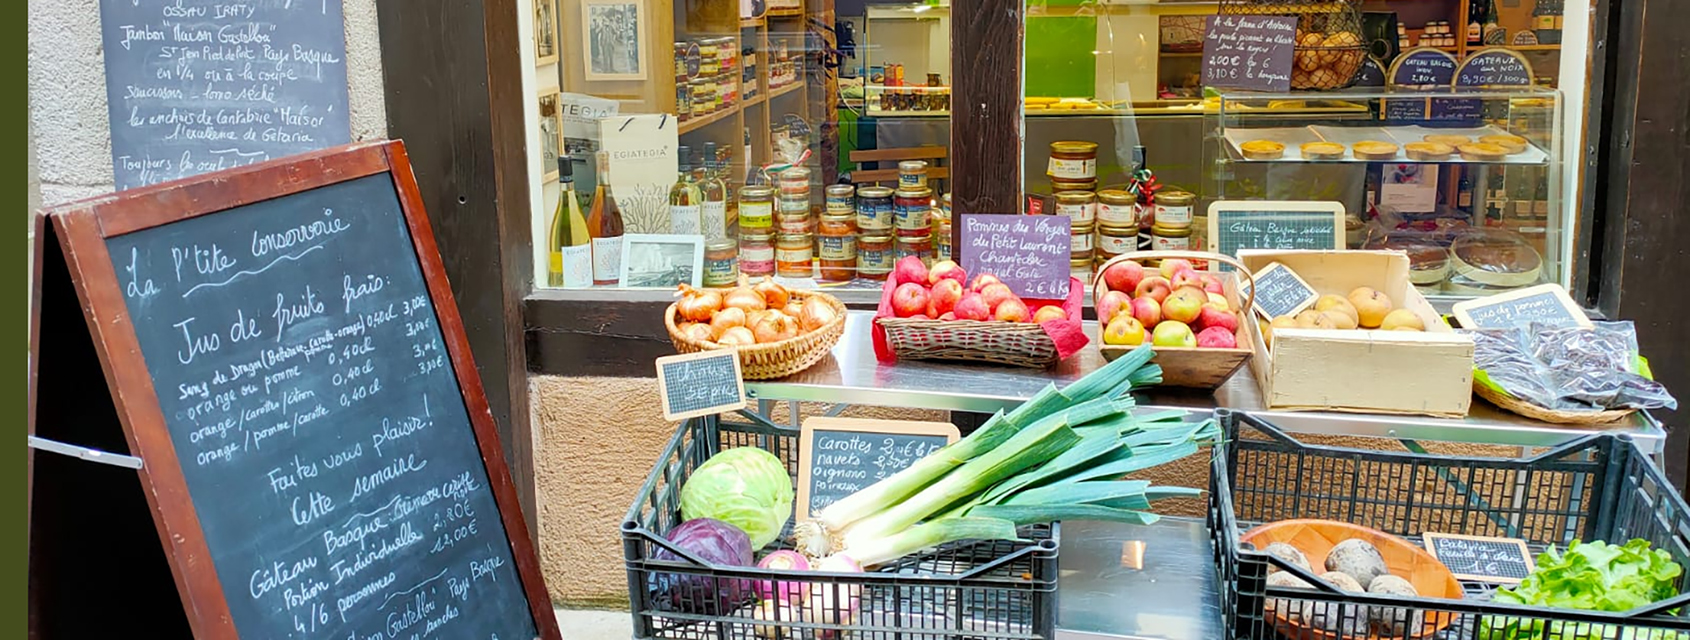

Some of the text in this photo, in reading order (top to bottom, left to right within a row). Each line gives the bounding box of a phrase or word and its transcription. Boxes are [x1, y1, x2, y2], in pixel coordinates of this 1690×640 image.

[163, 5, 255, 19] OSSAU IRATY
[156, 68, 172, 80] en
[204, 69, 221, 81] ou
[230, 309, 261, 342] de
[272, 285, 324, 343] fruits
[265, 365, 301, 394] pomme
[818, 434, 872, 453] Carottes
